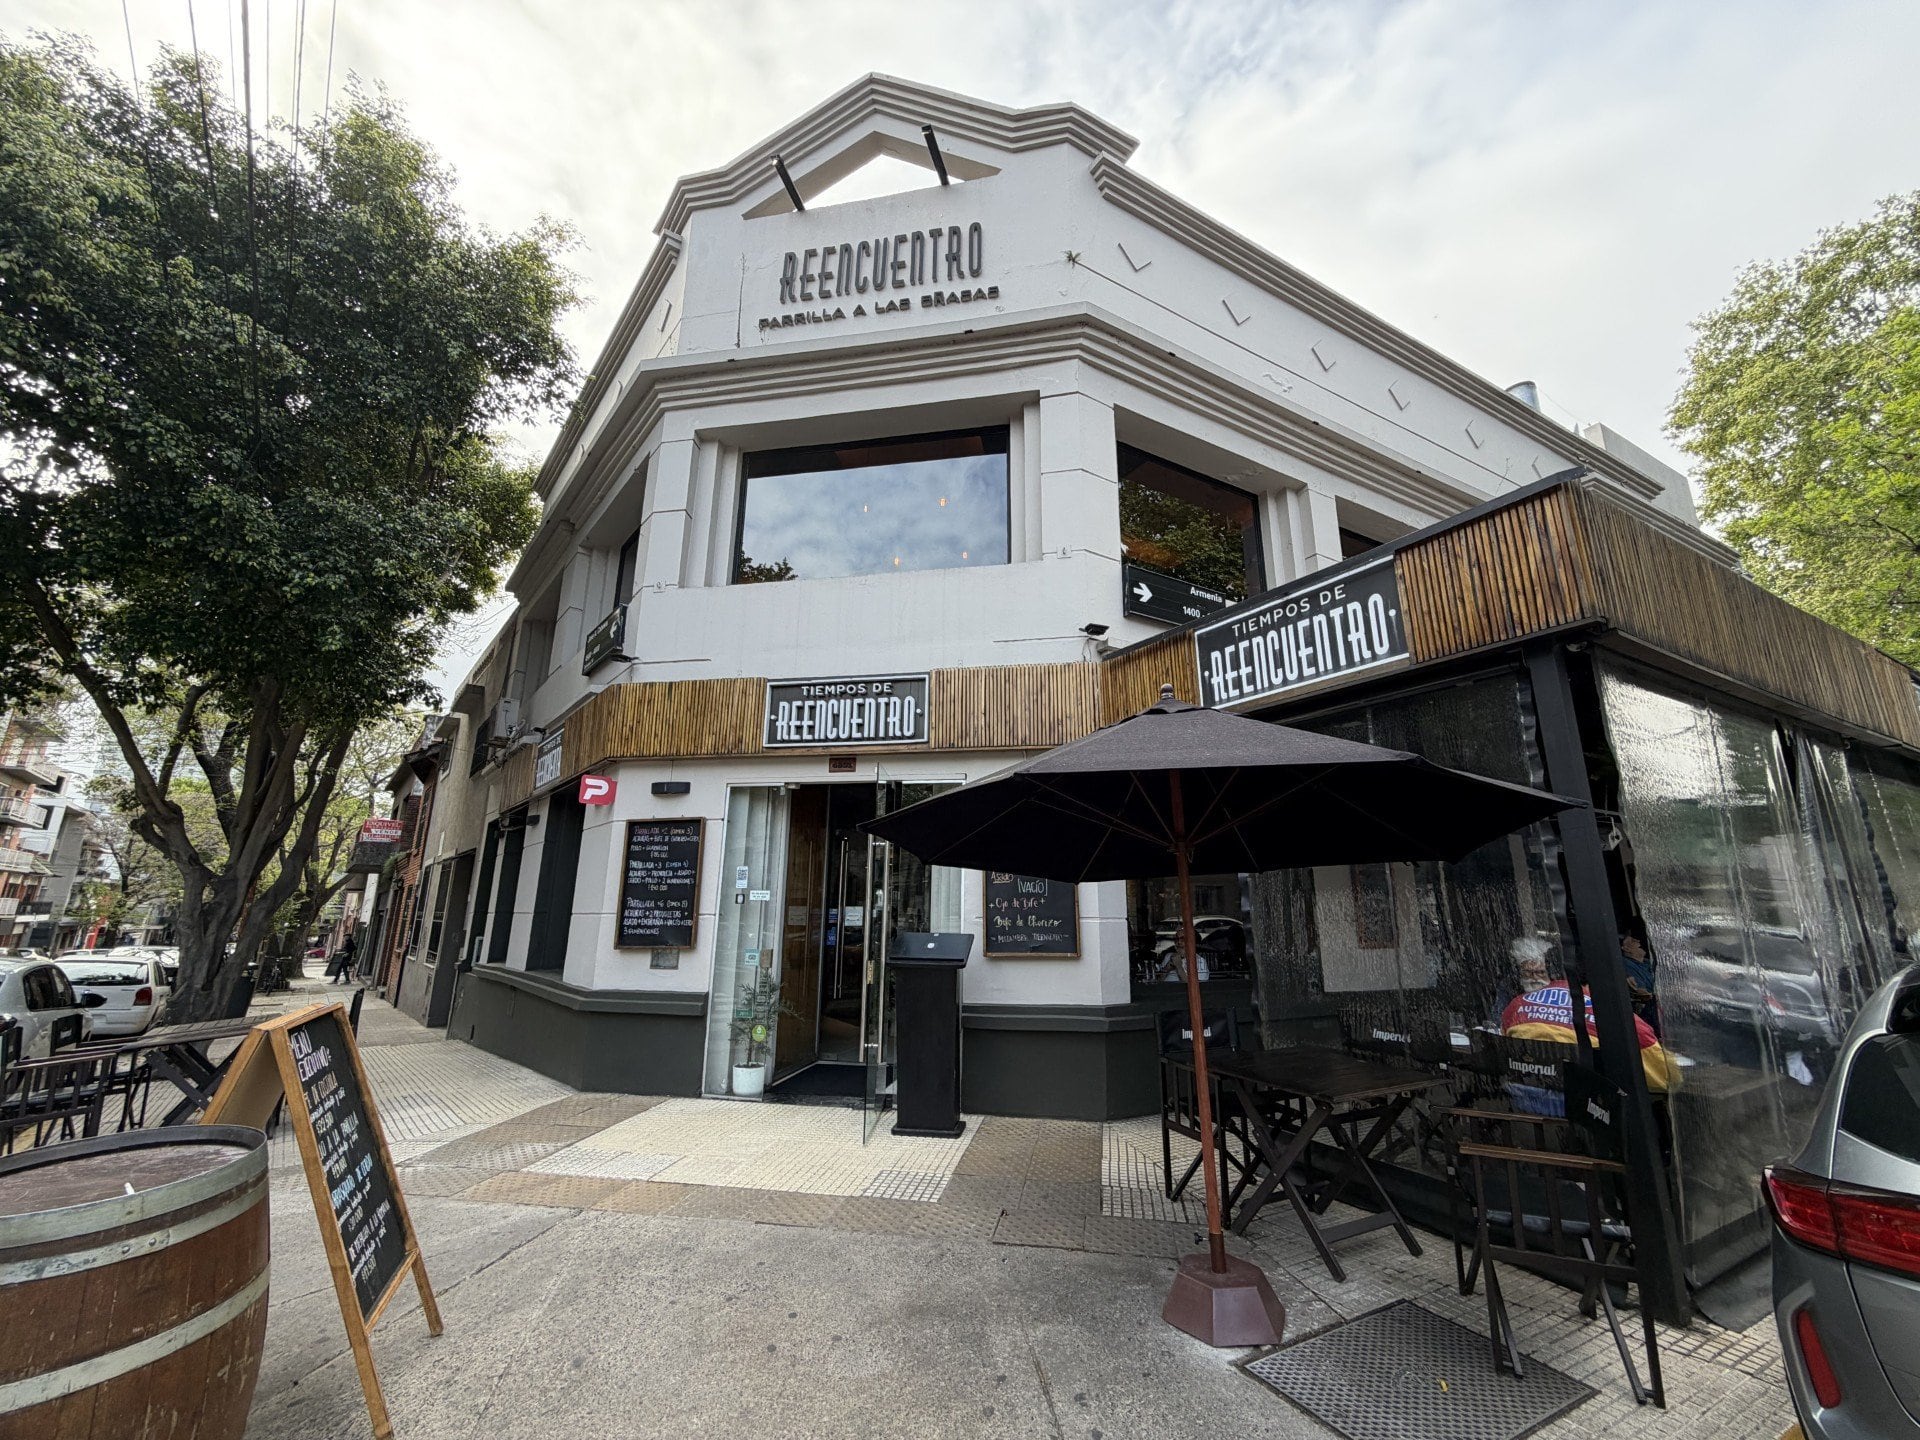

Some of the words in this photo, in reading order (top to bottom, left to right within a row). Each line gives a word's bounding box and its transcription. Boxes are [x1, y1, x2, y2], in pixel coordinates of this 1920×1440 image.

[779, 221, 982, 304] REENCUENTRO
[759, 307, 846, 330] PARRILLA
[853, 304, 867, 317] A
[875, 298, 910, 314] LAS
[921, 286, 999, 308] BRASAS
[1182, 606, 1200, 618] 1400
[1190, 586, 1222, 602] Armenia
[1232, 602, 1310, 636] TIEMPOS
[1319, 584, 1347, 606] DE
[1211, 593, 1390, 701] REENCUENTRO
[801, 683, 866, 696] TIEMPOS
[872, 682, 893, 693] DE
[776, 695, 916, 741] REENCUENTRO
[1508, 1057, 1557, 1076] Imperial
